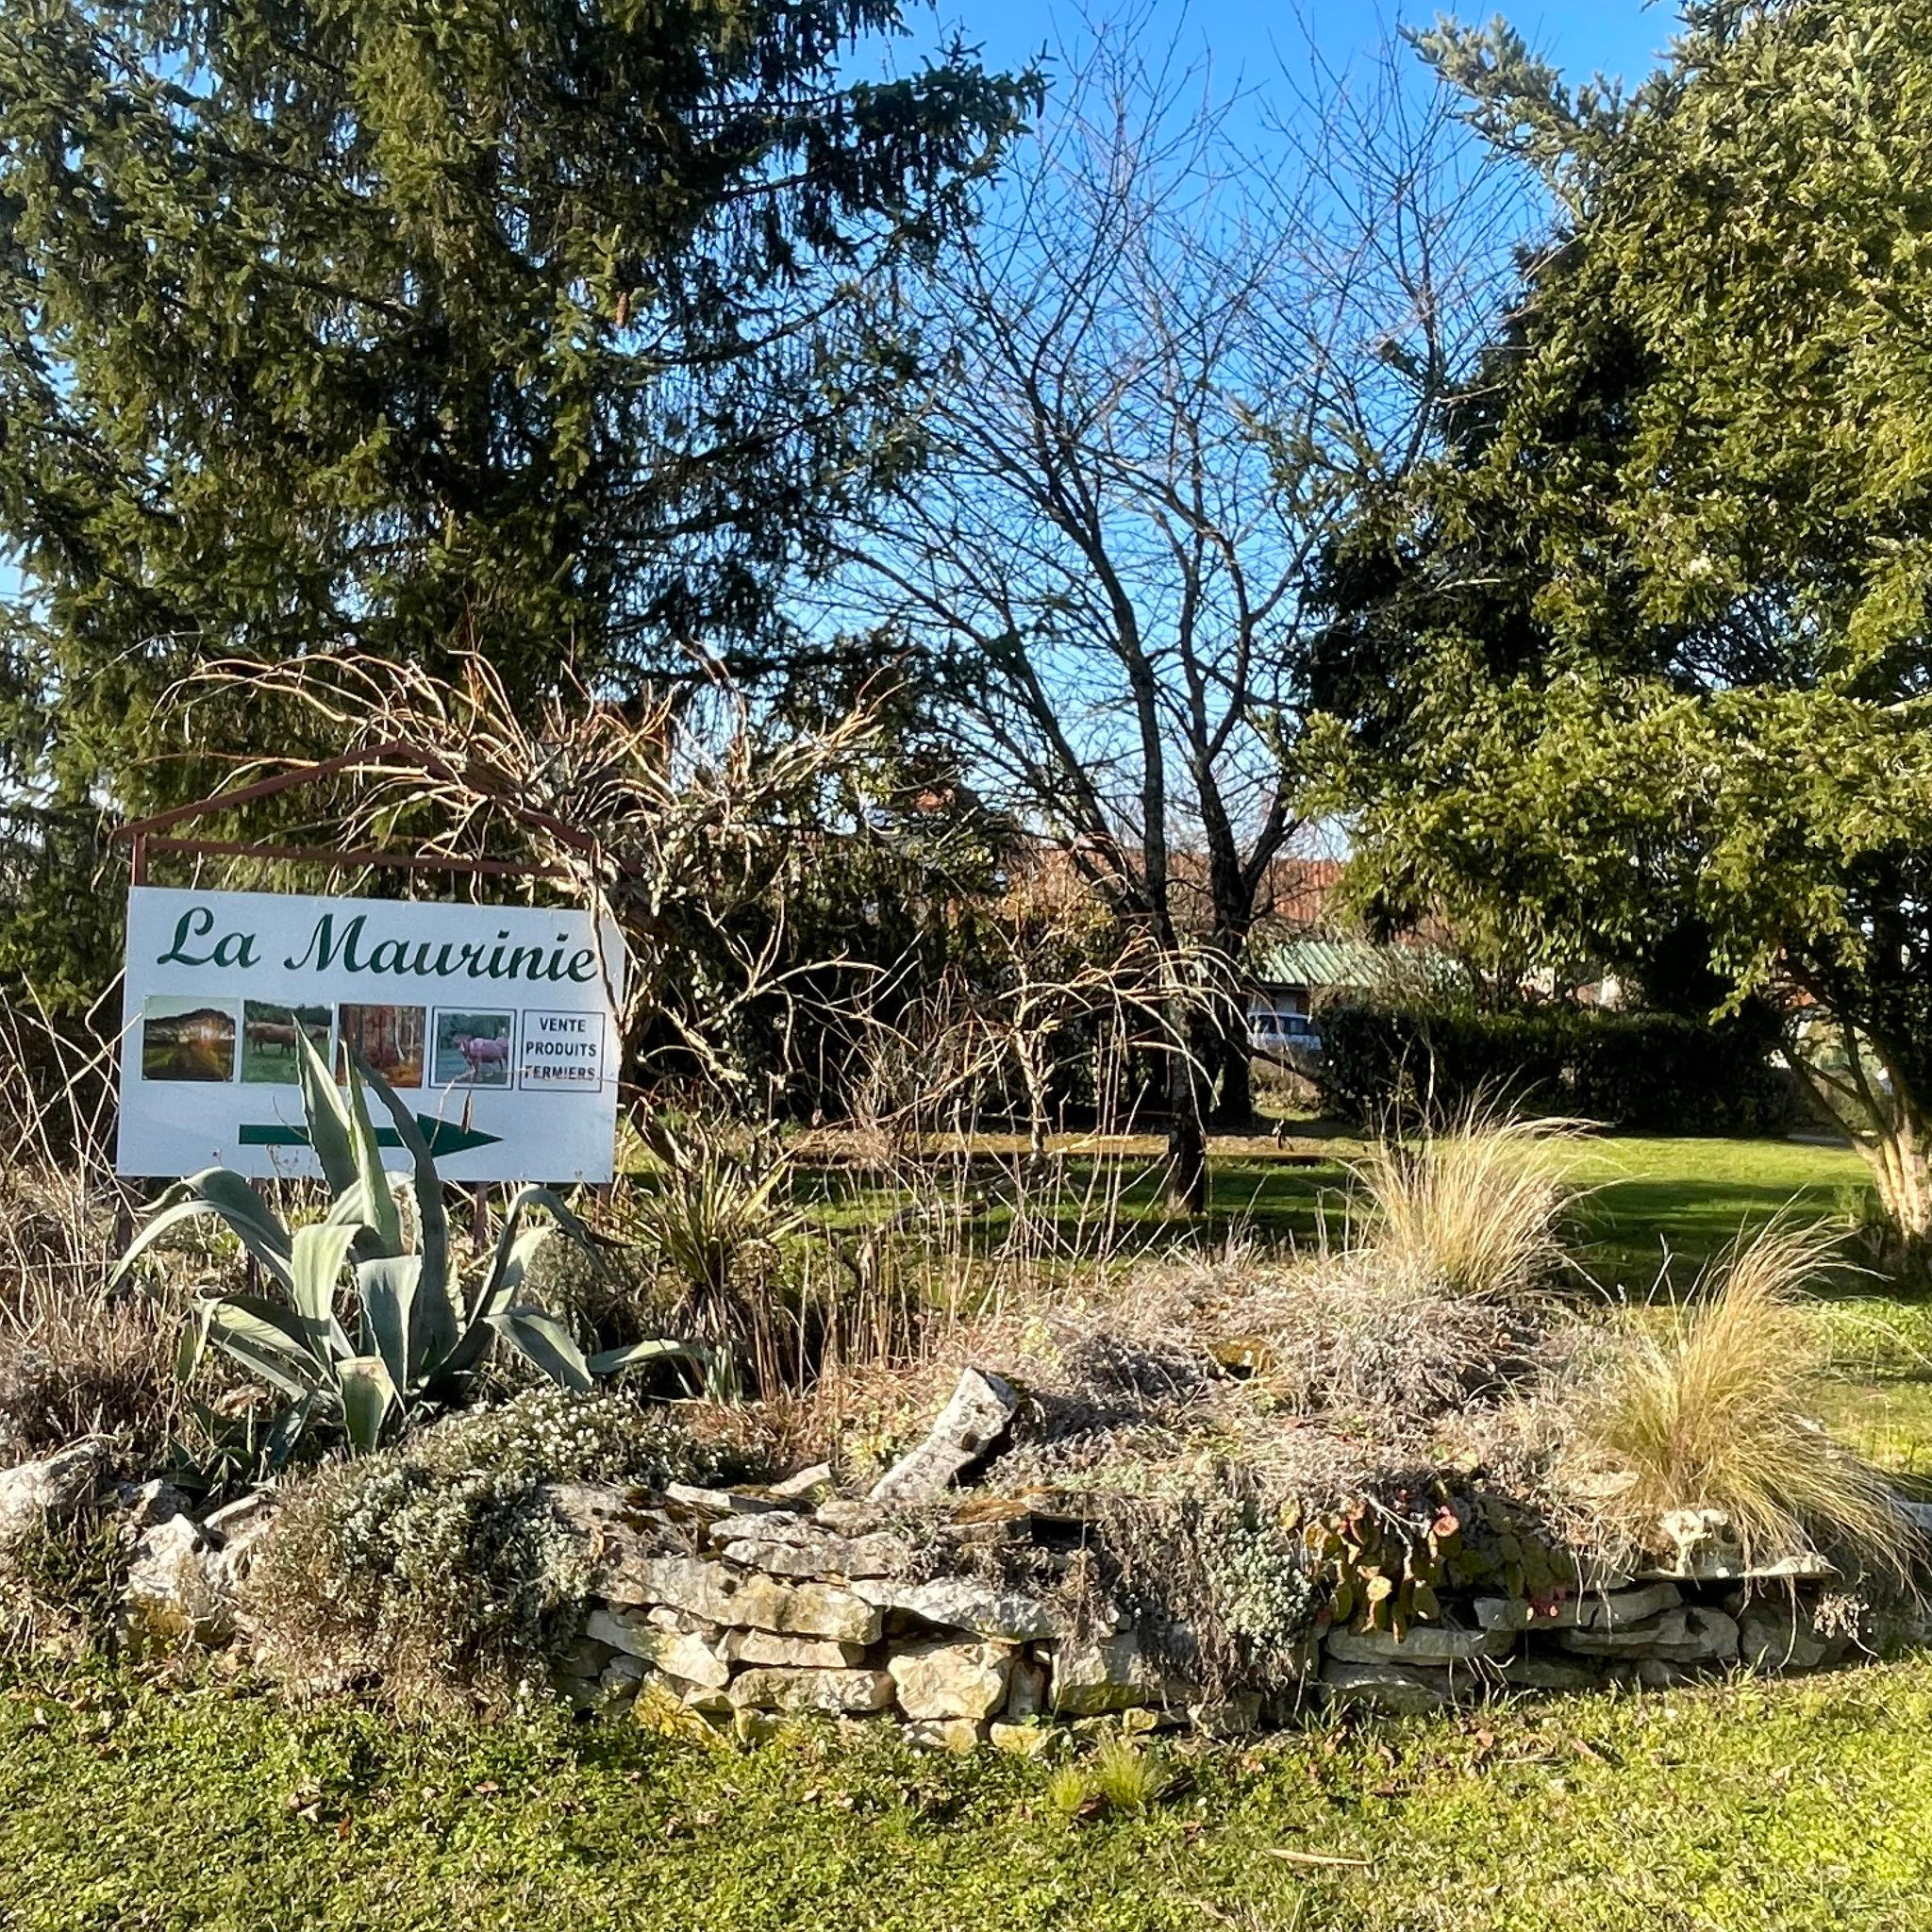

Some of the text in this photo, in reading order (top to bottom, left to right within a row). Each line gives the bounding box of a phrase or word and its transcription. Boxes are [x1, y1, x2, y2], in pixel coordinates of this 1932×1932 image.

[157, 906, 599, 982] La Maurinie
[539, 1017, 586, 1032] VENTE
[525, 1041, 596, 1057] PRODUITS
